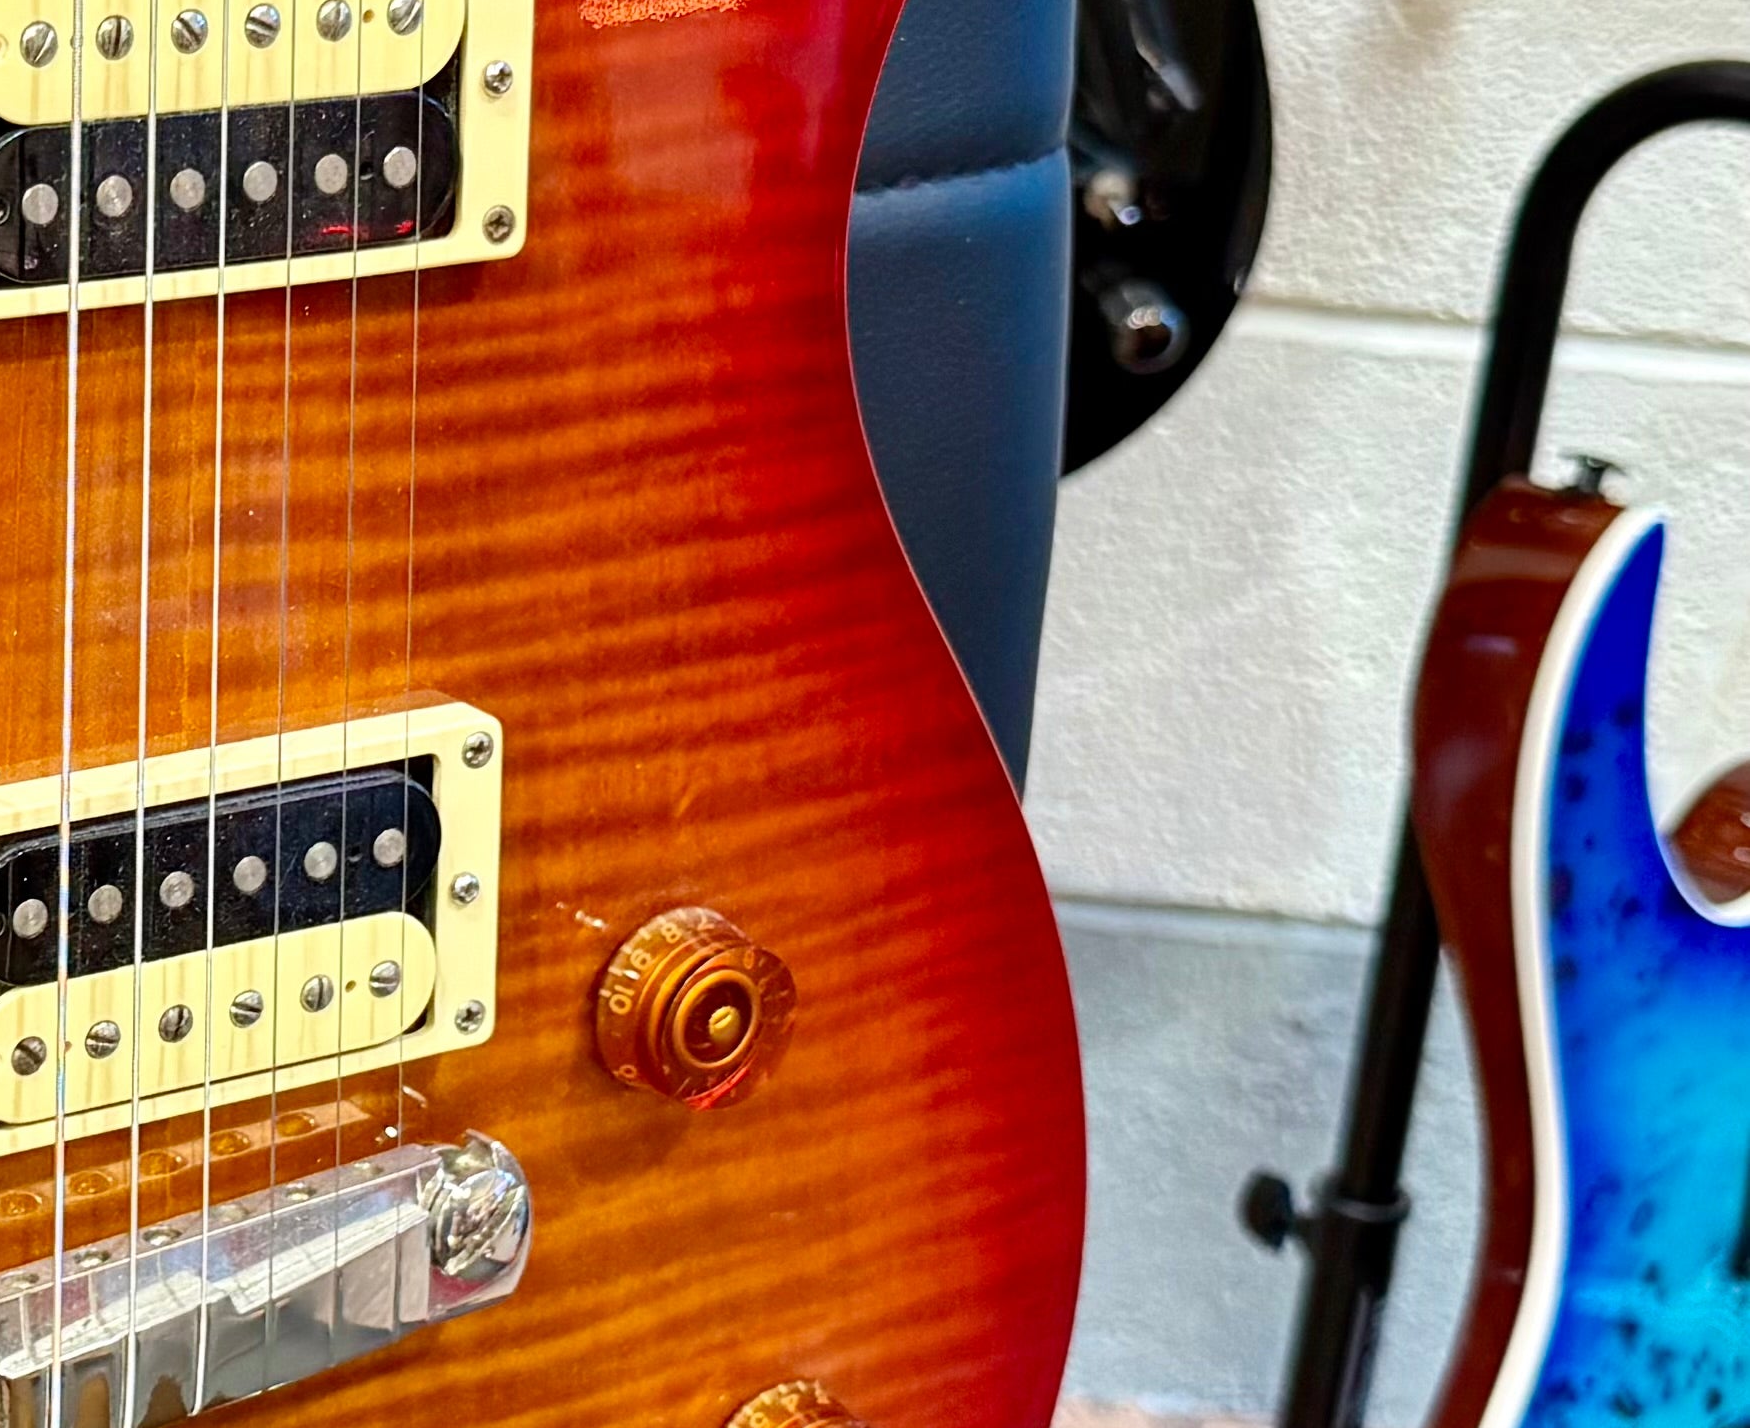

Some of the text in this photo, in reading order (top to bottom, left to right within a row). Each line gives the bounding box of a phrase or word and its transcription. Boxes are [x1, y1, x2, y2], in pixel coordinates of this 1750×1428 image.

[660, 922, 682, 943] 8
[630, 948, 652, 970] 9
[609, 984, 635, 1015] 10
